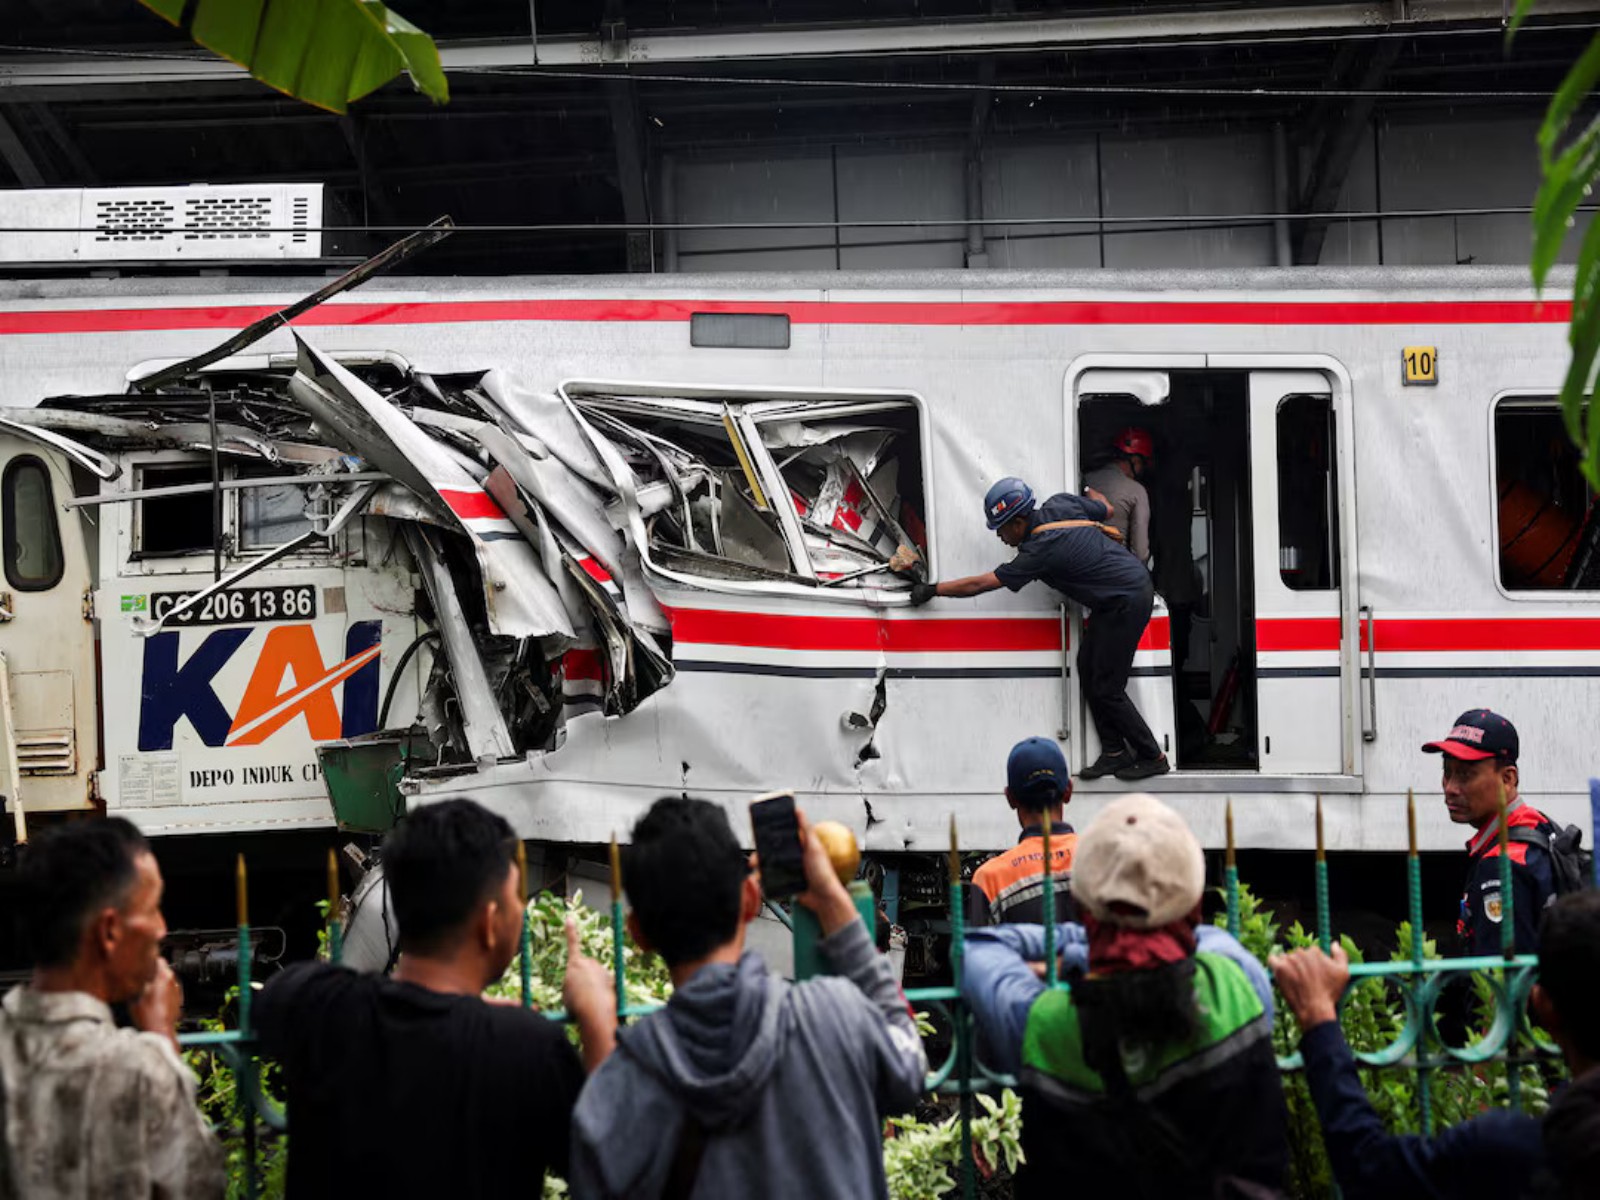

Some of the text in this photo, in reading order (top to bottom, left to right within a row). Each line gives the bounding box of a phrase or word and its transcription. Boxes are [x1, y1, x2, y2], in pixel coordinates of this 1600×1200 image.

[1408, 352, 1431, 375] 10
[200, 591, 245, 620] 206
[250, 590, 276, 618] 13
[282, 588, 312, 616] 86
[138, 619, 383, 752] KAI
[190, 768, 235, 788] DEPO
[242, 764, 294, 785] INDUK
